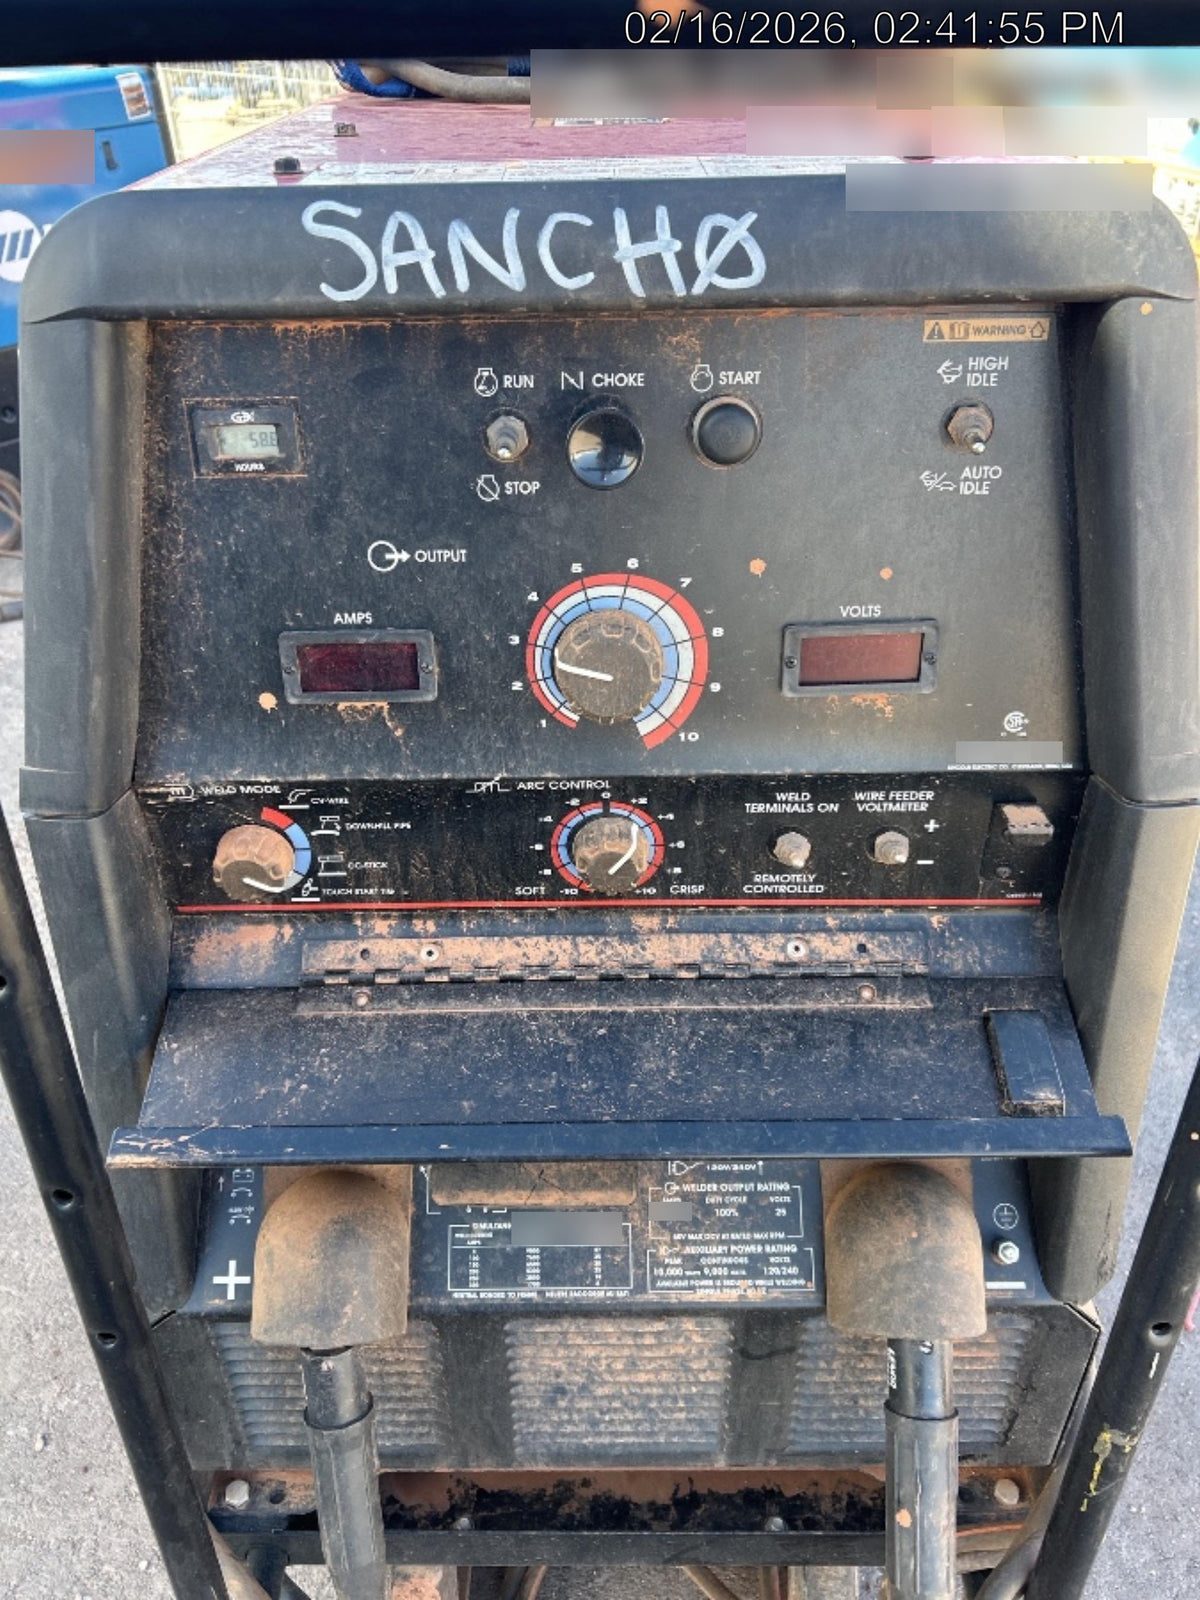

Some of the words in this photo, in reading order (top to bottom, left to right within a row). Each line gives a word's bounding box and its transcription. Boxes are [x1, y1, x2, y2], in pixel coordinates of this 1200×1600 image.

[972, 324, 1027, 336] WARNING
[968, 356, 1009, 371] HIGH
[503, 374, 534, 389] RUN
[591, 372, 645, 388] CHOKE
[718, 370, 762, 385] START
[966, 372, 999, 387] IDLE
[960, 465, 1002, 480] AUTO
[504, 480, 541, 495] STOP
[959, 481, 991, 495] IDLE
[414, 549, 467, 563] OUTPUT
[571, 563, 583, 573] 5
[627, 557, 639, 569] 6
[680, 577, 692, 588] 7
[527, 591, 539, 602] 4
[839, 604, 882, 618] VOLTS
[333, 611, 373, 625] AMPS
[712, 627, 725, 637] 8
[508, 635, 520, 645] 3
[511, 680, 524, 691] 2
[709, 682, 721, 693] 9
[540, 719, 547, 728] 1
[678, 731, 700, 742] 10
[239, 785, 282, 794] MODE
[516, 781, 545, 790] ARC
[548, 779, 610, 790] CONTROL
[775, 792, 811, 802] WELD
[854, 791, 886, 801] WIRE
[888, 790, 935, 801] FEEDER
[744, 802, 814, 814] TERMINALS
[817, 802, 840, 813] ON
[856, 801, 929, 812] VOLTMETER
[753, 873, 816, 883] REMOTELY
[514, 886, 546, 895] SOFT
[634, 886, 657, 895] +10
[669, 884, 705, 895] CRISP
[742, 884, 825, 894] CONTROLLED
[682, 1182, 718, 1192] WELDER
[719, 1182, 755, 1192] OUTPUT
[756, 1181, 791, 1191] RATING
[714, 1208, 739, 1217] 100%
[730, 1244, 763, 1253] POWER
[764, 1243, 798, 1253] RATING
[763, 1266, 800, 1275] 120/240
